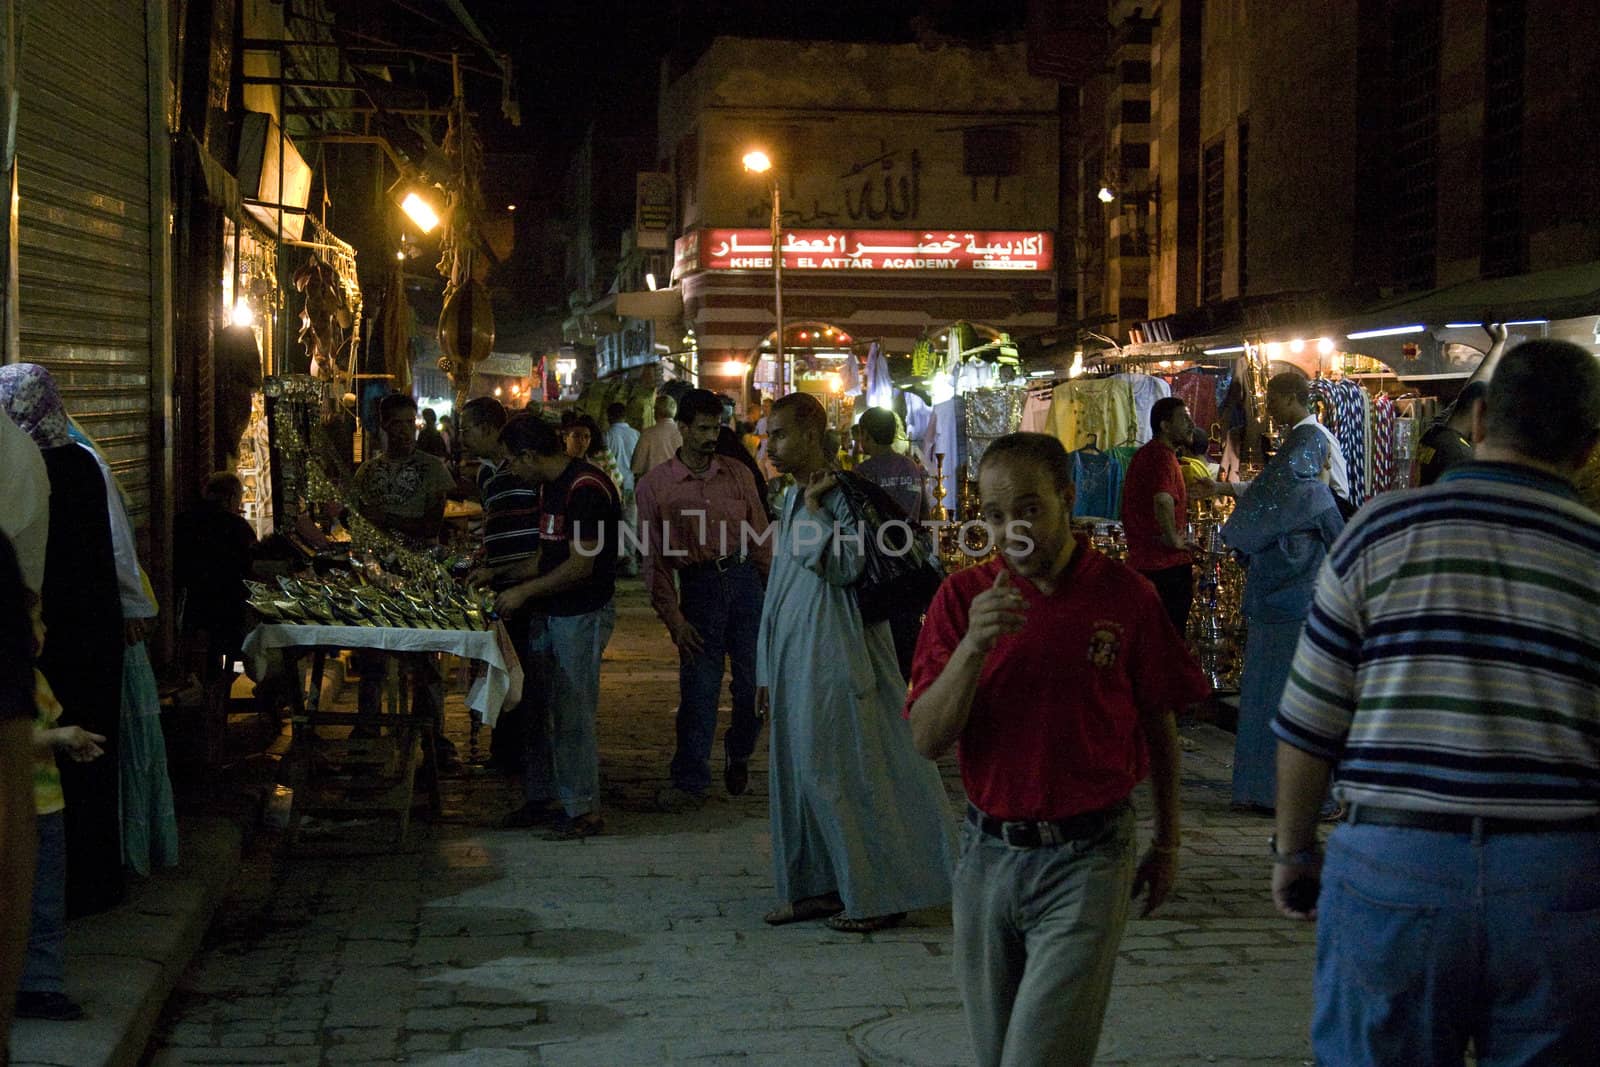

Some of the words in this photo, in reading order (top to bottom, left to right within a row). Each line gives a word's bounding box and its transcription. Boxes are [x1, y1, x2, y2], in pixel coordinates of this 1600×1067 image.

[712, 233, 846, 257] العطار
[847, 234, 961, 257] خضر
[797, 257, 817, 268] EL
[821, 257, 872, 268] ATTAR
[883, 258, 959, 269] ACADEMY
